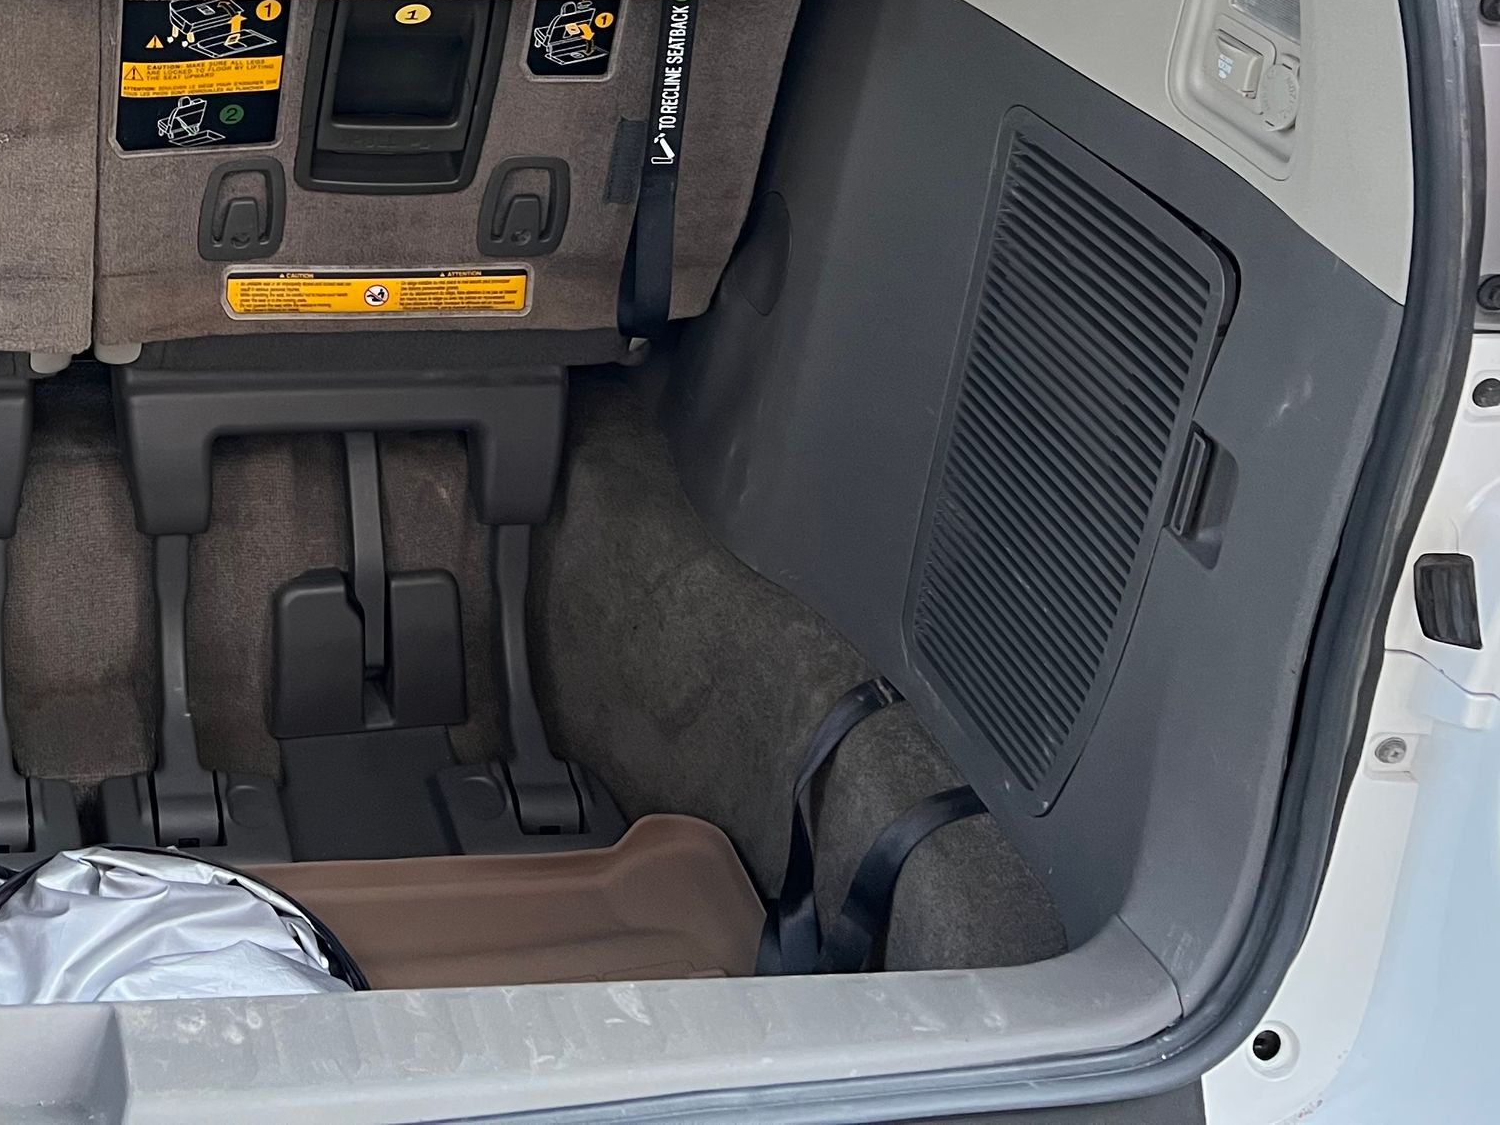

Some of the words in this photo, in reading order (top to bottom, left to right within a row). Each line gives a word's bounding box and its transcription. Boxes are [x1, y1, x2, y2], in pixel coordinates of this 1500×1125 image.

[265, 3, 272, 18] 1
[405, 9, 419, 20] 1
[601, 15, 608, 25] 1
[666, 5, 690, 65] SEATBACK
[660, 66, 682, 114] RECLINE
[226, 108, 239, 122] 2
[658, 115, 677, 130] TO
